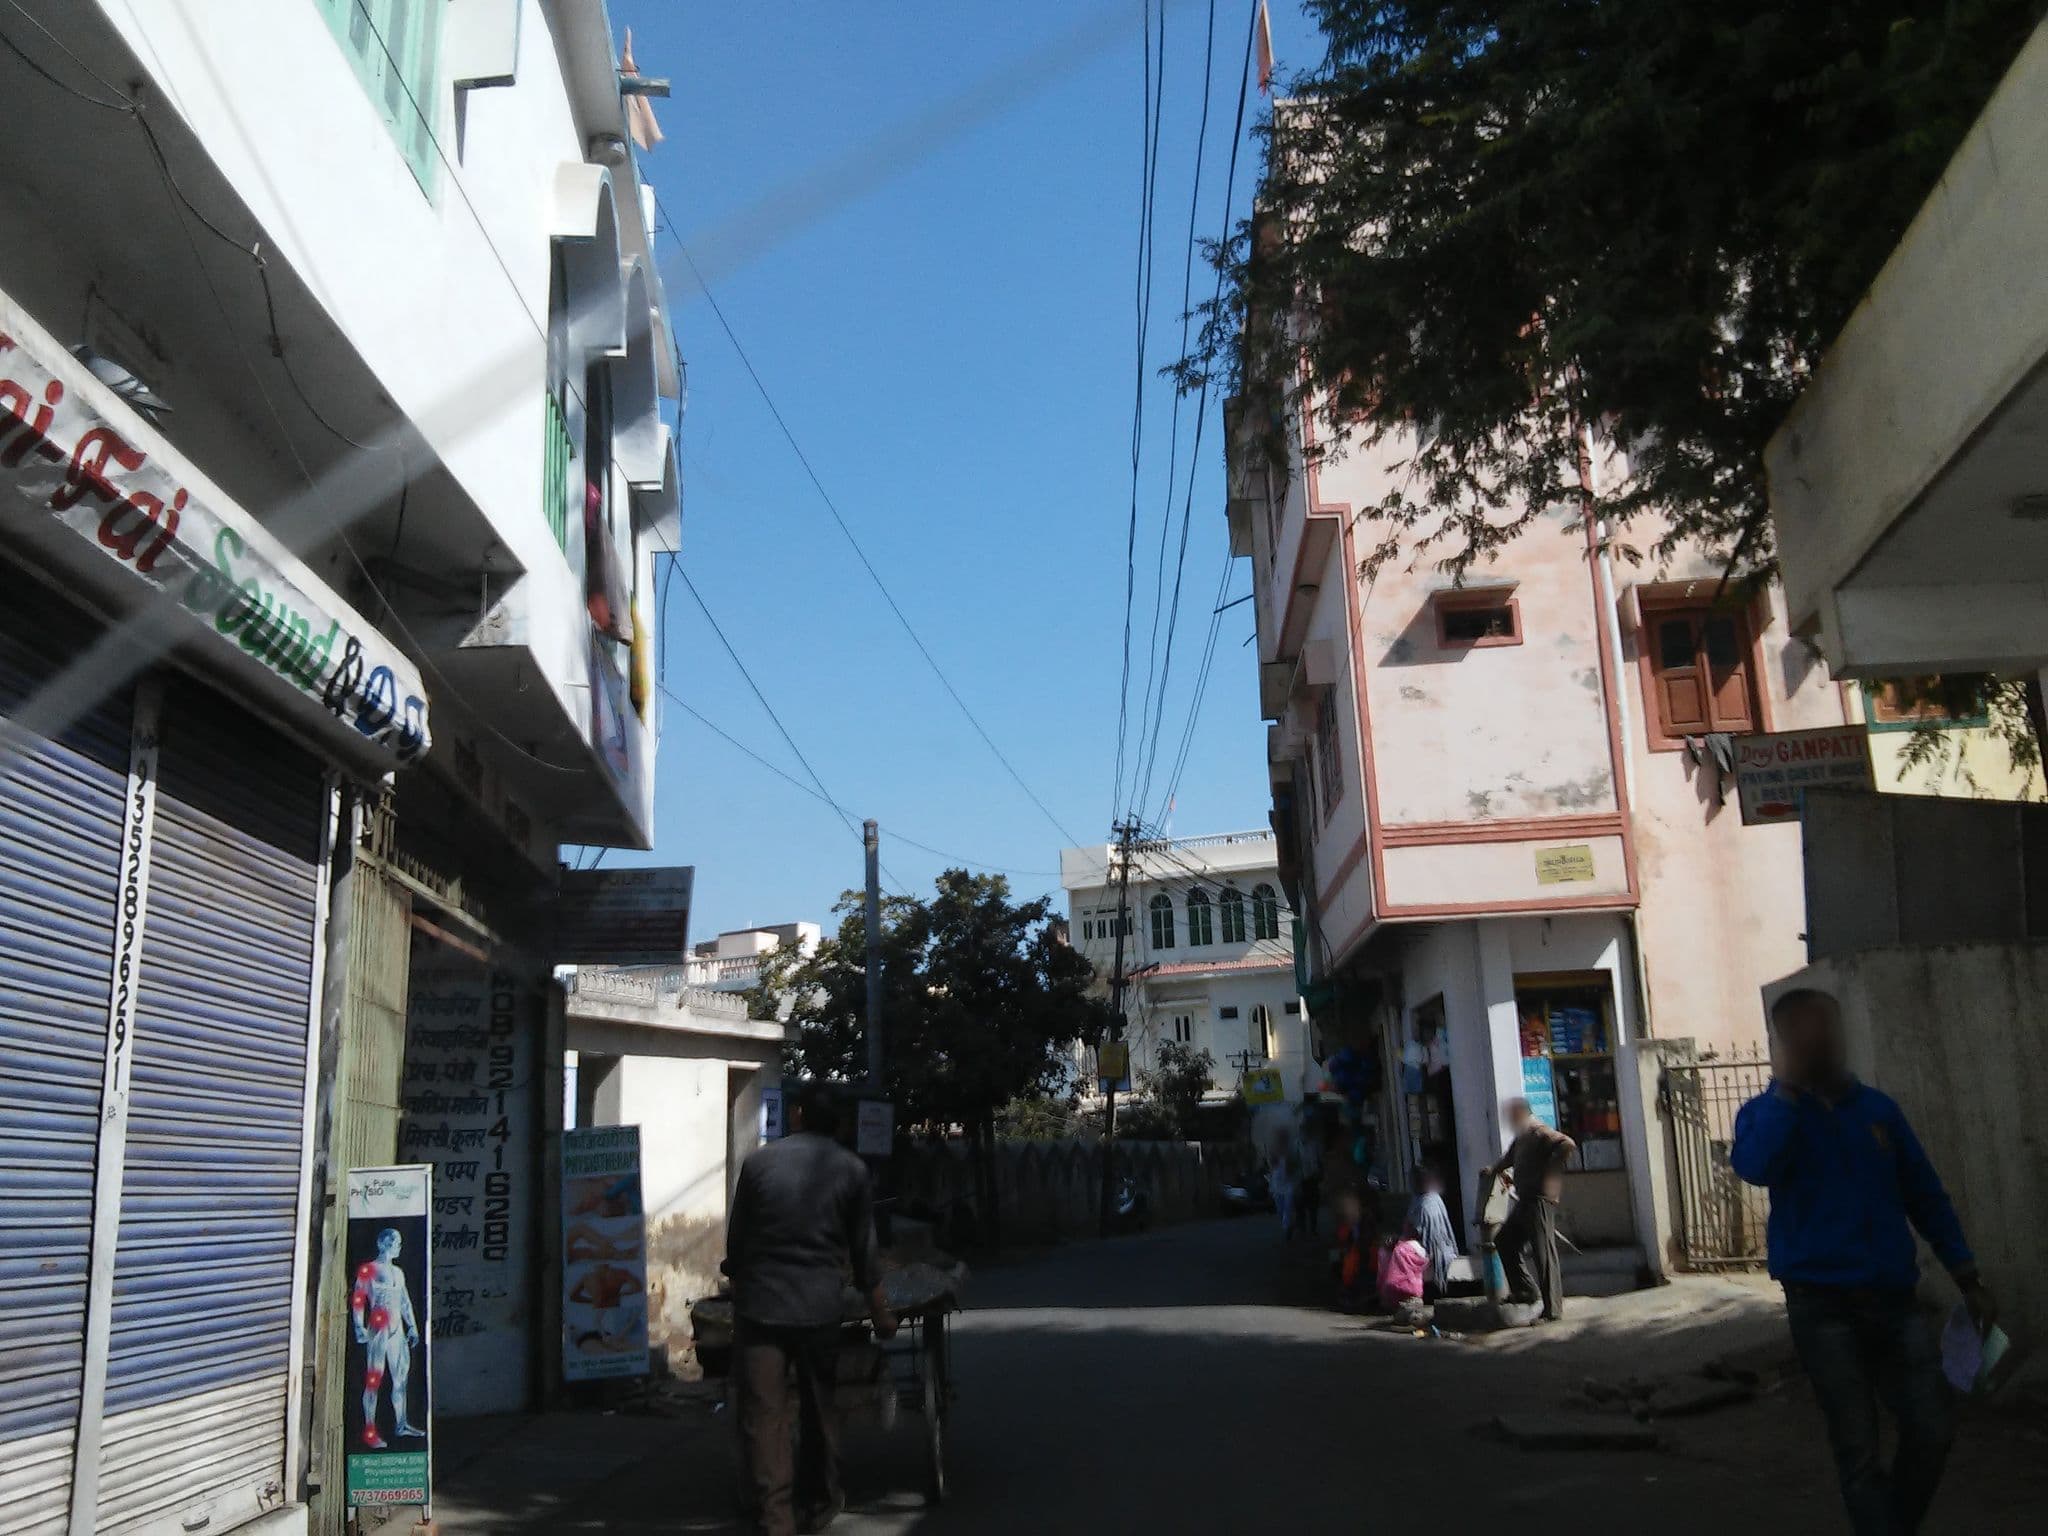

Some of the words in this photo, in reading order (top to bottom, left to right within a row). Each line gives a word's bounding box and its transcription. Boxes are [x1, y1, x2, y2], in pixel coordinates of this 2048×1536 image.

[183, 526, 341, 690] Sound
[323, 635, 363, 717] &
[1775, 735, 1863, 762] GANPATI
[352, 1488, 424, 1503] 7737669965
